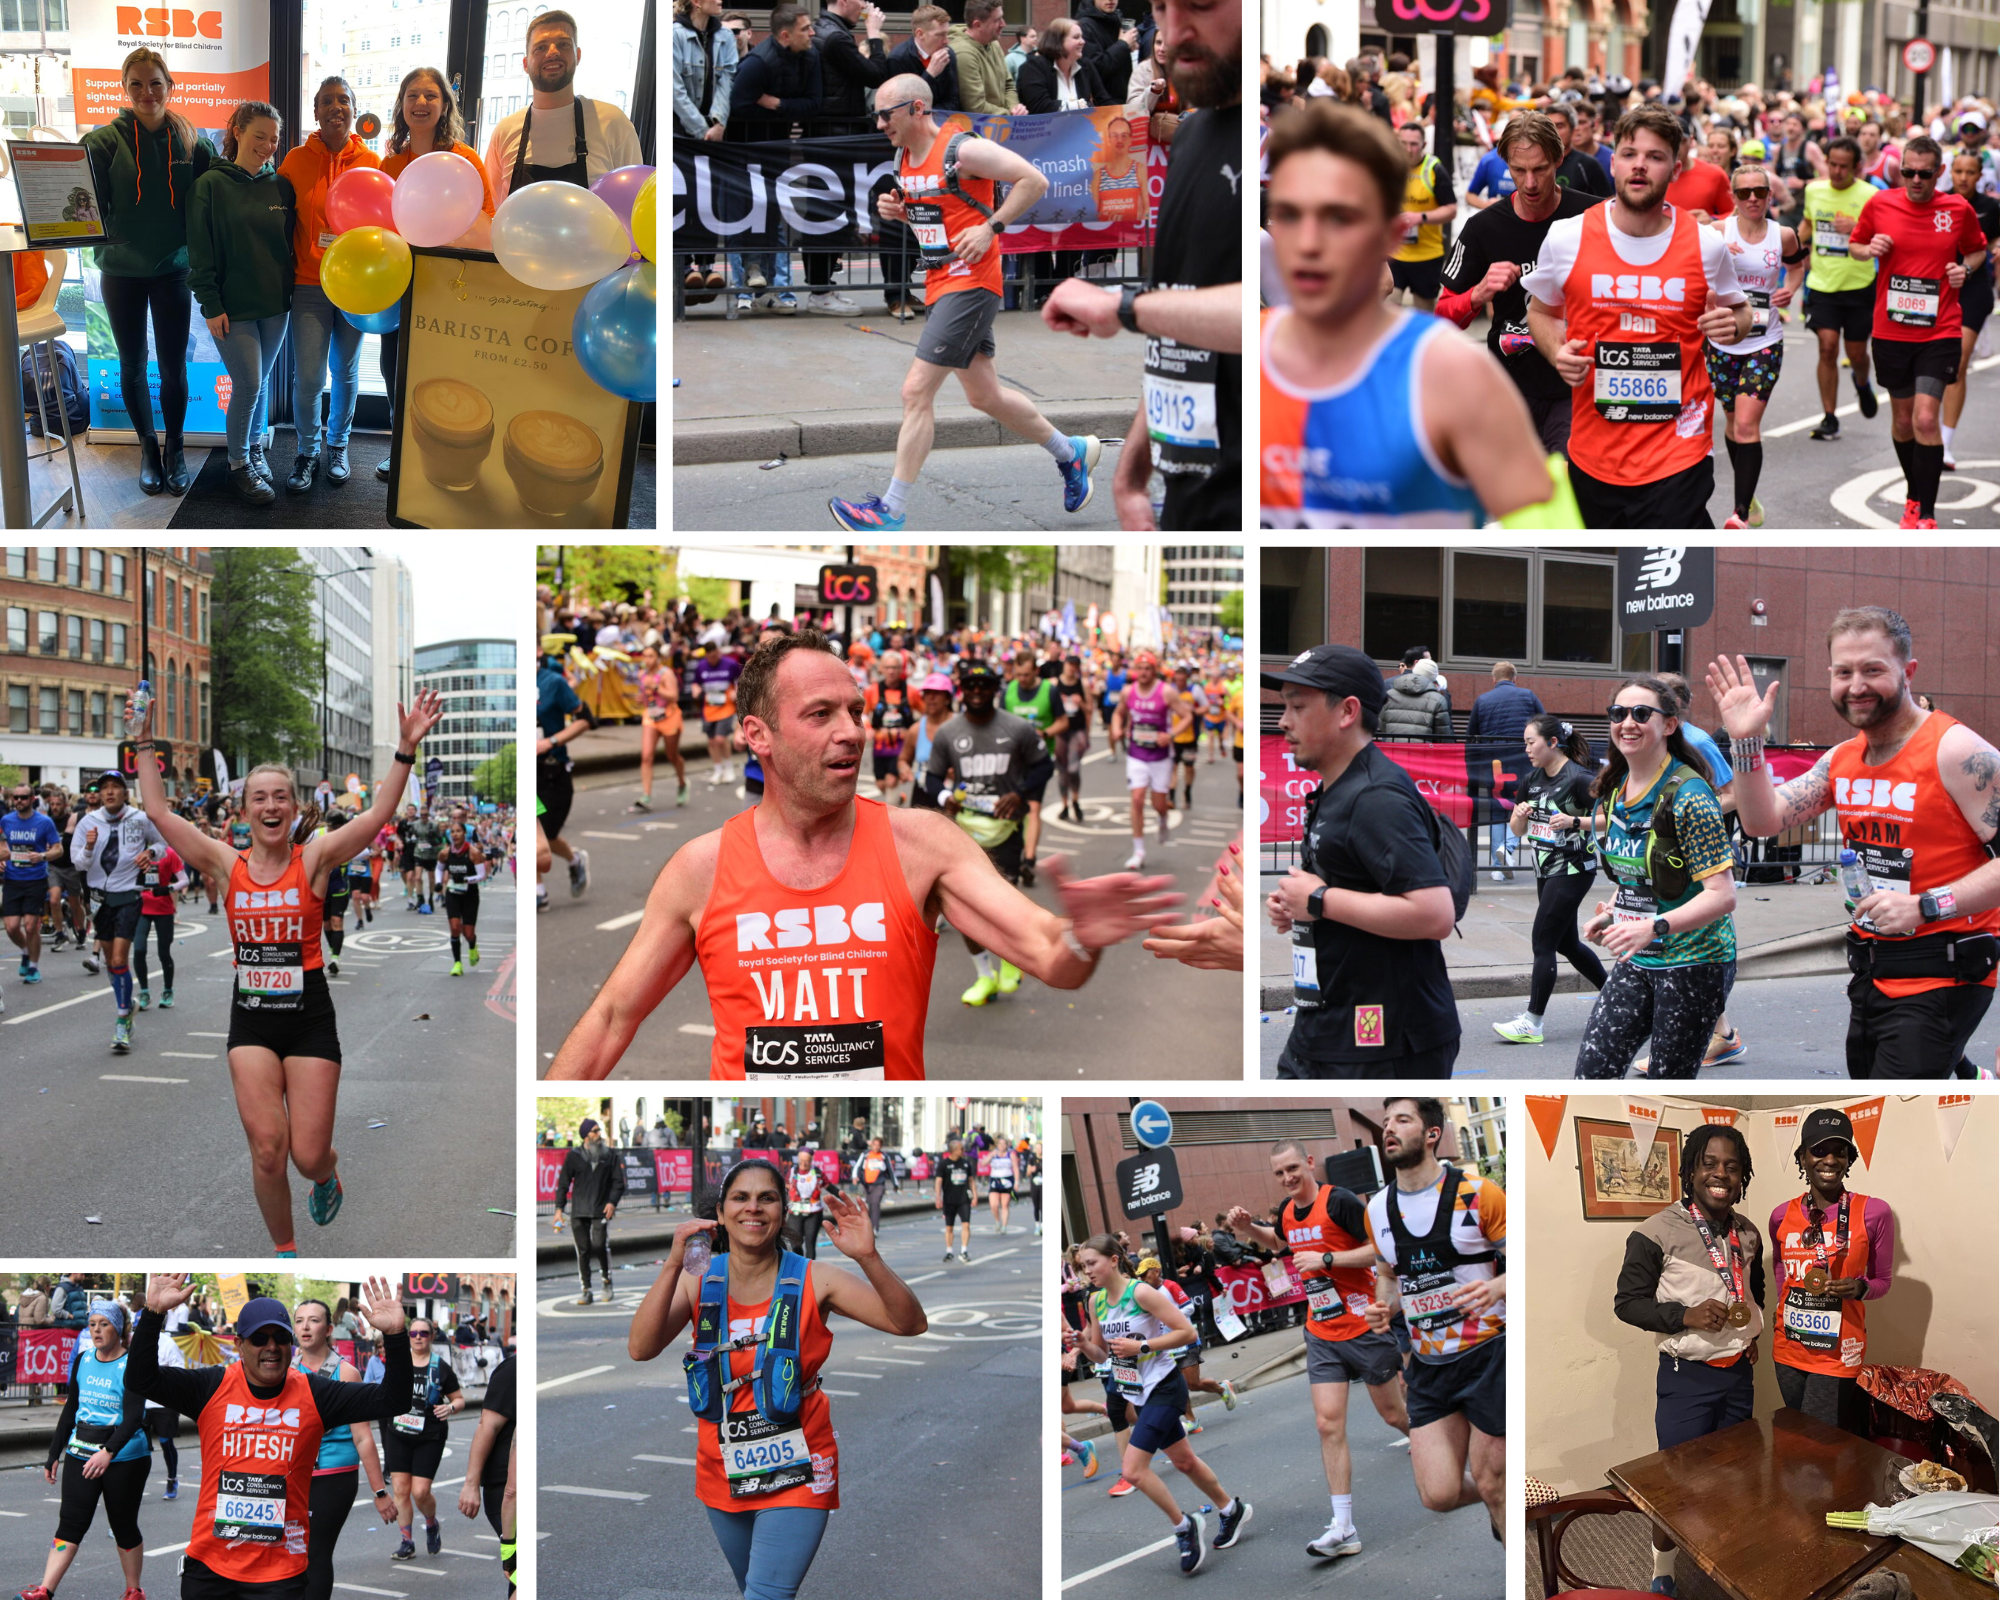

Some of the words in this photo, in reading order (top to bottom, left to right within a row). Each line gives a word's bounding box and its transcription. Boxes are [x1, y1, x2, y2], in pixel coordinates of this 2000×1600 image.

[116, 6, 222, 39] RSBC
[118, 40, 138, 50] Royal
[138, 41, 164, 50] Society
[193, 43, 223, 51] Children
[186, 83, 226, 94] partially
[86, 92, 122, 103] sighted
[184, 97, 214, 107] young
[87, 107, 105, 115] and
[106, 106, 120, 115] the
[1032, 154, 1087, 174] Smash
[674, 155, 895, 235] uer
[1053, 179, 1088, 197] line!
[1521, 260, 1539, 277] Ph
[1591, 274, 1686, 302] RSBC
[1738, 275, 1767, 286] KAREN
[1891, 276, 1909, 290] tcs
[512, 300, 549, 313] eating
[1592, 301, 1609, 310] Royal
[1609, 302, 1631, 310] Society
[1657, 304, 1684, 312] Children
[1897, 296, 1927, 311] 8069
[1505, 322, 1530, 334] tcs
[1620, 312, 1657, 334] Dan
[415, 315, 512, 347] BARISTA
[524, 335, 574, 357] COF
[474, 350, 508, 363] FROM
[513, 357, 548, 371] £2.50
[1599, 346, 1629, 366] tcs
[1632, 359, 1660, 367] SERVICES
[1608, 377, 1668, 398] 55866
[1643, 412, 1673, 420] balance
[824, 568, 871, 601] tcs
[1626, 598, 1646, 614] new
[1647, 592, 1694, 612] balance
[124, 746, 166, 774] ts
[1835, 777, 1918, 812] RSBC
[1843, 810, 1863, 818] Society
[1870, 811, 1886, 819] Blind
[1886, 813, 1914, 823] Children
[10, 829, 36, 841] SIMON
[1848, 821, 1901, 845] LIAM
[1605, 836, 1642, 858] MARY
[1866, 848, 1882, 857] TATA
[1866, 856, 1906, 868] CONSULTANCY
[1866, 863, 1890, 874] SERVICES
[234, 888, 300, 909] RSBC
[1615, 891, 1625, 905] cs
[234, 916, 304, 942] RUTH
[736, 902, 887, 952] RSBC
[239, 945, 260, 962] tcs
[738, 957, 765, 969] Royal
[766, 954, 803, 966] Society
[804, 952, 819, 962] for
[820, 951, 845, 961] Blind
[846, 949, 888, 959] Children
[246, 971, 292, 988] 19720
[804, 1032, 835, 1043] TATA
[752, 1034, 800, 1066] tcs
[804, 1040, 875, 1054] CONSULTANCY
[805, 1053, 851, 1065] SERVICES
[1937, 1095, 1971, 1106] RSBC
[1628, 1104, 1657, 1119] RSBC
[1850, 1106, 1879, 1121] RSBC
[1707, 1116, 1731, 1125] RSBC
[1774, 1115, 1798, 1125] RSBC
[658, 1156, 676, 1186] tcs
[1127, 1200, 1141, 1210] new
[1140, 1190, 1171, 1206] balance
[1288, 1225, 1323, 1243] RSBC
[1784, 1231, 1852, 1249] RB
[1709, 1246, 1724, 1267] 2024
[408, 1273, 449, 1294] tcs
[1418, 1271, 1450, 1285] CONSULTANCY
[1419, 1280, 1440, 1289] SERVICES
[1411, 1291, 1453, 1314] 15235
[1788, 1290, 1803, 1306] tcs
[1101, 1321, 1131, 1335] MADDIE
[1789, 1311, 1831, 1331] 65360
[1811, 1340, 1832, 1349] balance
[24, 1338, 58, 1375] tcs
[86, 1375, 112, 1388] CHAR
[93, 1392, 121, 1401] TUCKWELL
[99, 1400, 120, 1409] CARE
[224, 1403, 301, 1428] RSBC
[750, 1424, 779, 1436] SERVICES
[222, 1433, 295, 1462] HITESH
[734, 1439, 795, 1470] 64205
[812, 1457, 834, 1471] ithout
[221, 1475, 244, 1492] tcs
[246, 1482, 283, 1490] CONSULTANCY
[759, 1482, 774, 1491] new
[776, 1475, 806, 1487] balance
[225, 1501, 274, 1521] 66245
[253, 1532, 277, 1541] balance
